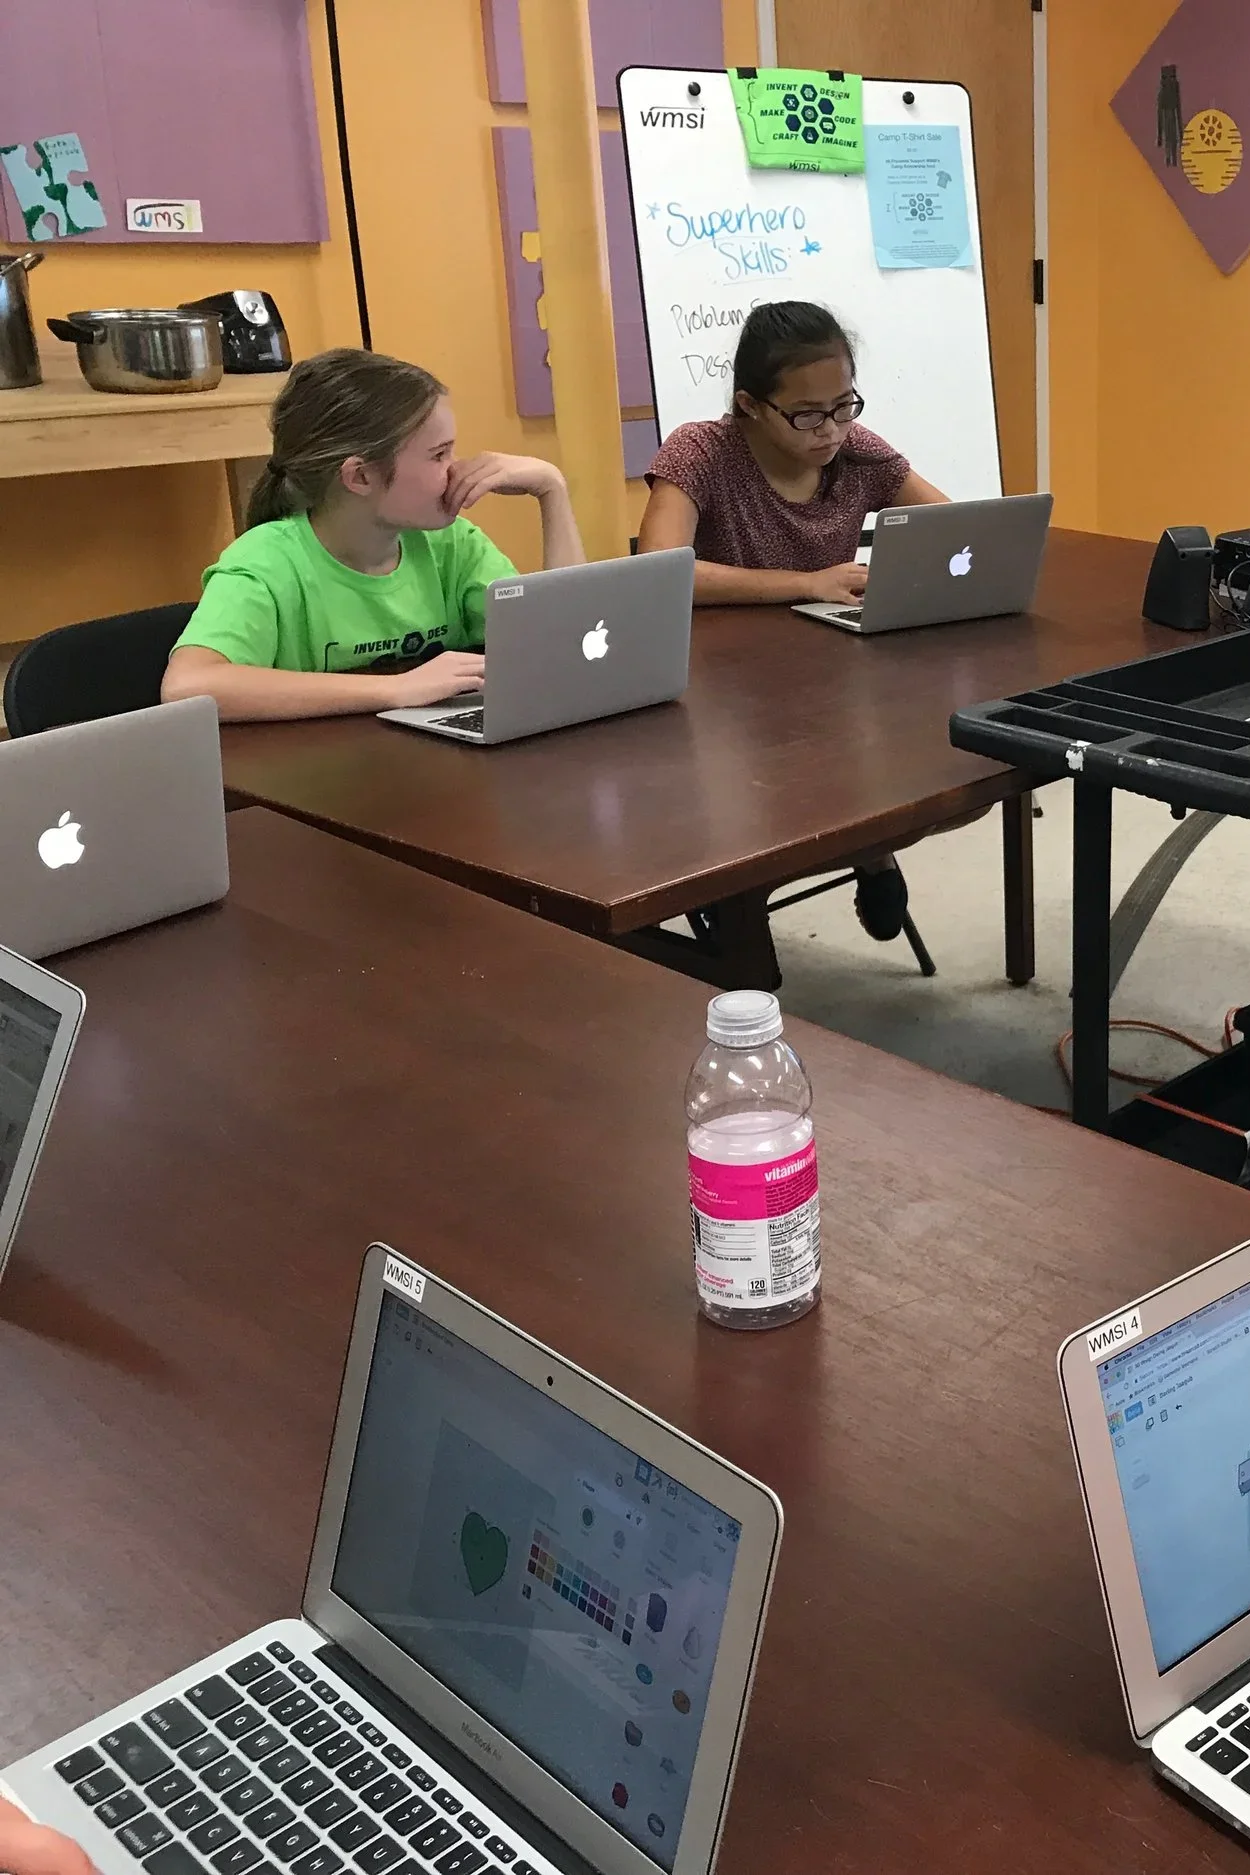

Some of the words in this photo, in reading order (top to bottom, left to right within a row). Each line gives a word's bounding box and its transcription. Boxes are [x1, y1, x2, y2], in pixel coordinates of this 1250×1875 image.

[765, 82, 798, 92] INVENT
[640, 106, 706, 130] wmsi
[759, 108, 785, 118] MAKE
[834, 114, 857, 125] CODE
[772, 132, 800, 142] CRAFT
[821, 136, 858, 149] IMAGINE
[877, 133, 901, 143] Camp
[926, 133, 943, 142] Sale
[788, 159, 822, 173] wmsi
[666, 202, 806, 248] Superhero
[670, 303, 748, 339] Problem
[427, 624, 449, 641] DES
[353, 638, 400, 656] INVENT
[769, 1215, 796, 1231] Nutrition
[386, 1260, 414, 1290] WMSI
[414, 1279, 422, 1295] 5
[750, 1279, 766, 1290] 120
[1088, 1325, 1128, 1353] WMSI
[1130, 1315, 1140, 1330] 4
[233, 1715, 248, 1727] Q
[254, 1735, 270, 1748] W
[277, 1757, 292, 1768] E
[218, 1766, 231, 1778] S
[300, 1779, 315, 1791] R
[239, 1788, 254, 1800] D
[184, 1803, 199, 1816] X
[324, 1801, 339, 1812] T
[263, 1811, 278, 1822] F
[207, 1827, 224, 1839] C
[349, 1824, 363, 1835] Y
[286, 1834, 300, 1846] G
[230, 1850, 246, 1862] V
[372, 1847, 388, 1860] U
[309, 1858, 325, 1871] H
